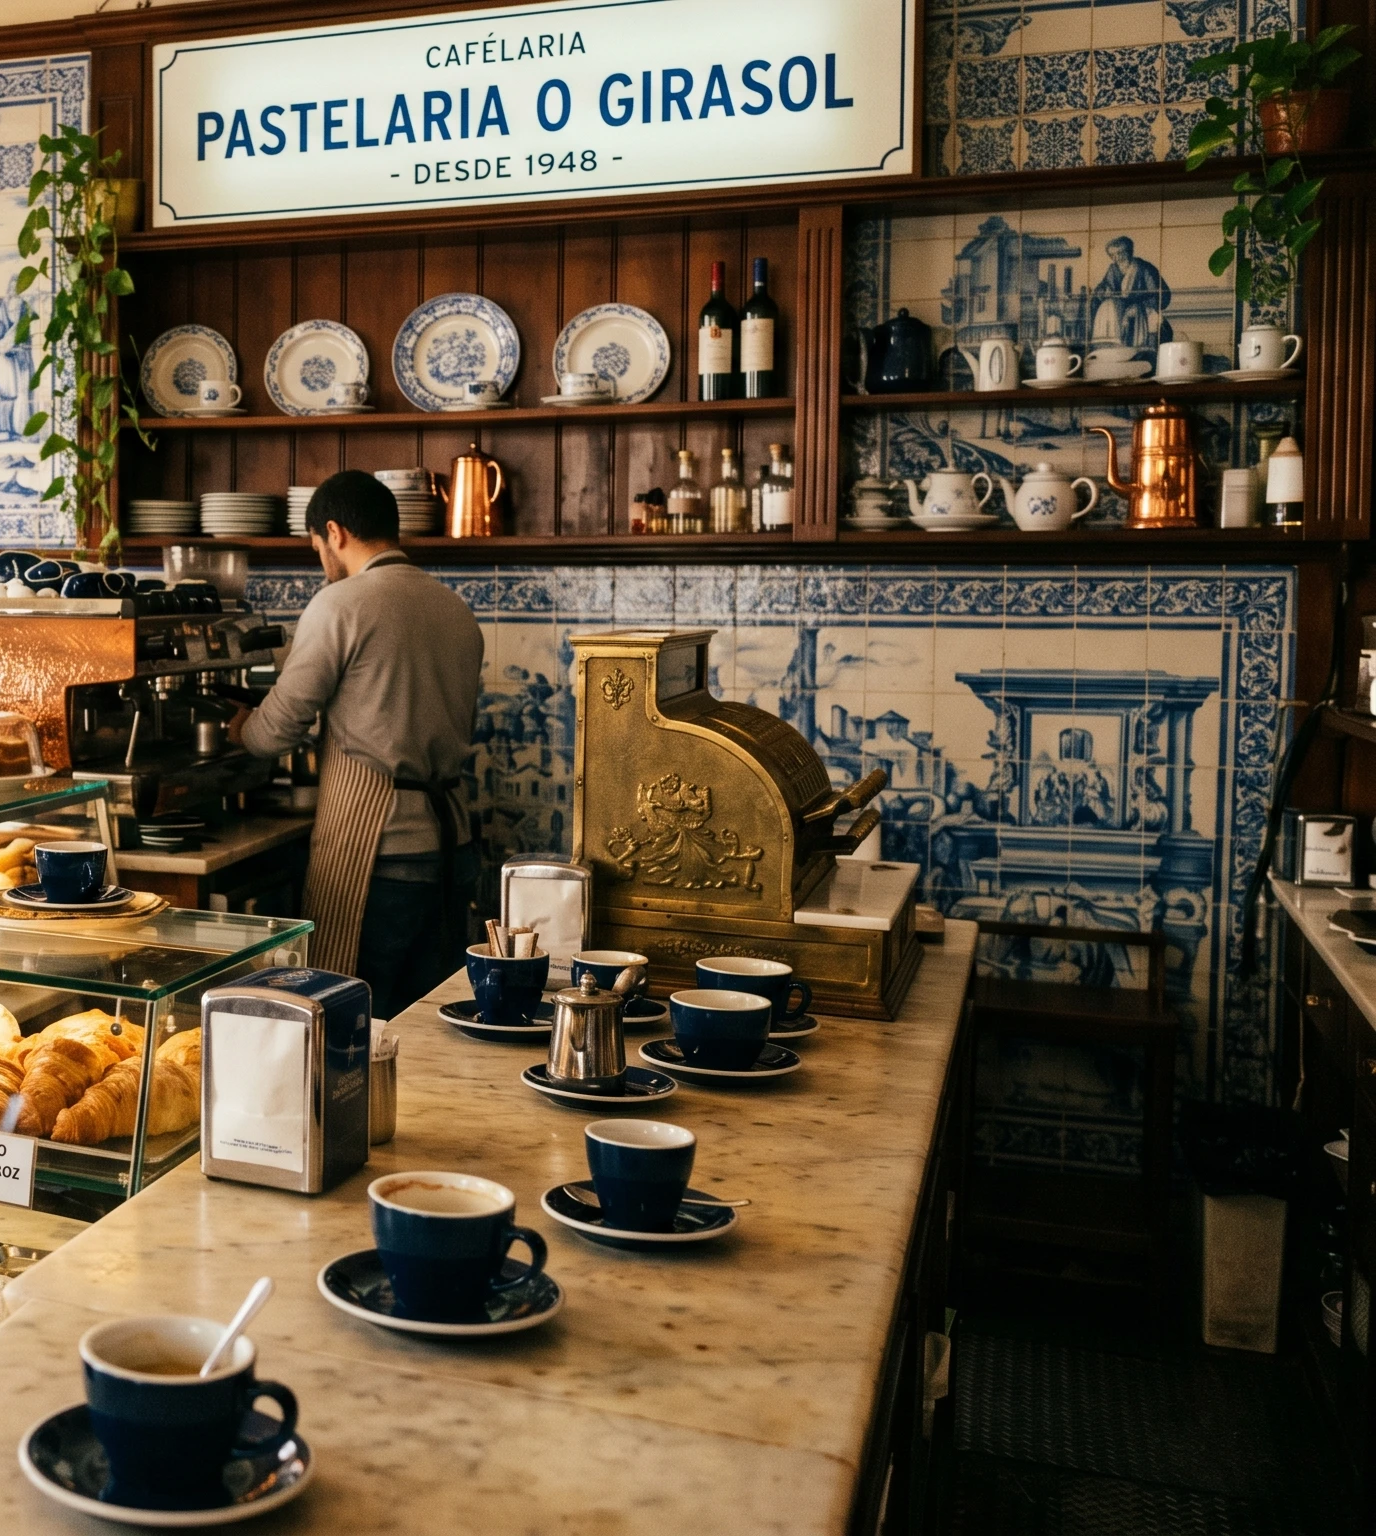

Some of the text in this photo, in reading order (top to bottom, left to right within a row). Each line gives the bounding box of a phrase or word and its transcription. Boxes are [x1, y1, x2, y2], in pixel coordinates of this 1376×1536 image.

[425, 31, 587, 69] CAFÉLARIA
[197, 53, 854, 161] PASTELARIA O GIRASOL
[414, 156, 512, 185] DESDE
[525, 149, 598, 176] 1948
